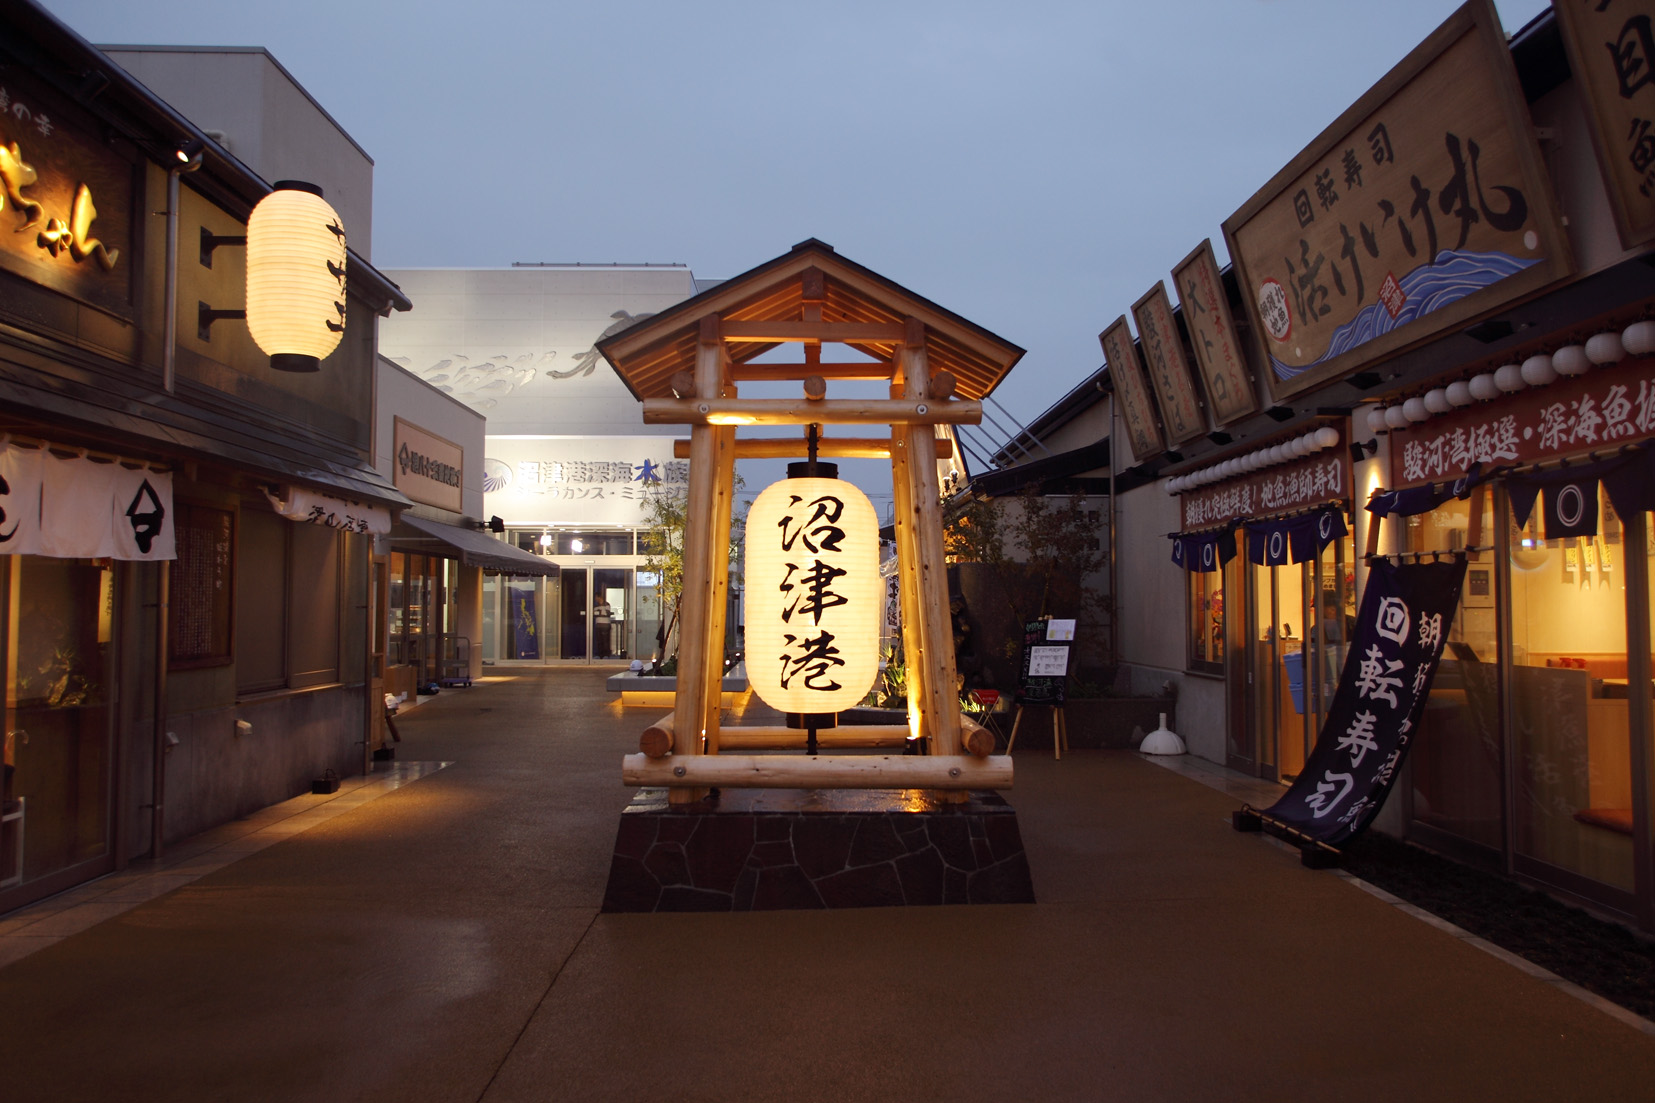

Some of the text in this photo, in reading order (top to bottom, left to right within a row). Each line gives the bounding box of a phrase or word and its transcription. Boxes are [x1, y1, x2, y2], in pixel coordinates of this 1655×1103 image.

[1285, 131, 1529, 326] 活けいけ丸
[1293, 122, 1394, 228] 回転寿司
[1187, 280, 1227, 400] 大トロ
[778, 495, 849, 692] 沼津港
[1305, 596, 1410, 819] 回転寿司
